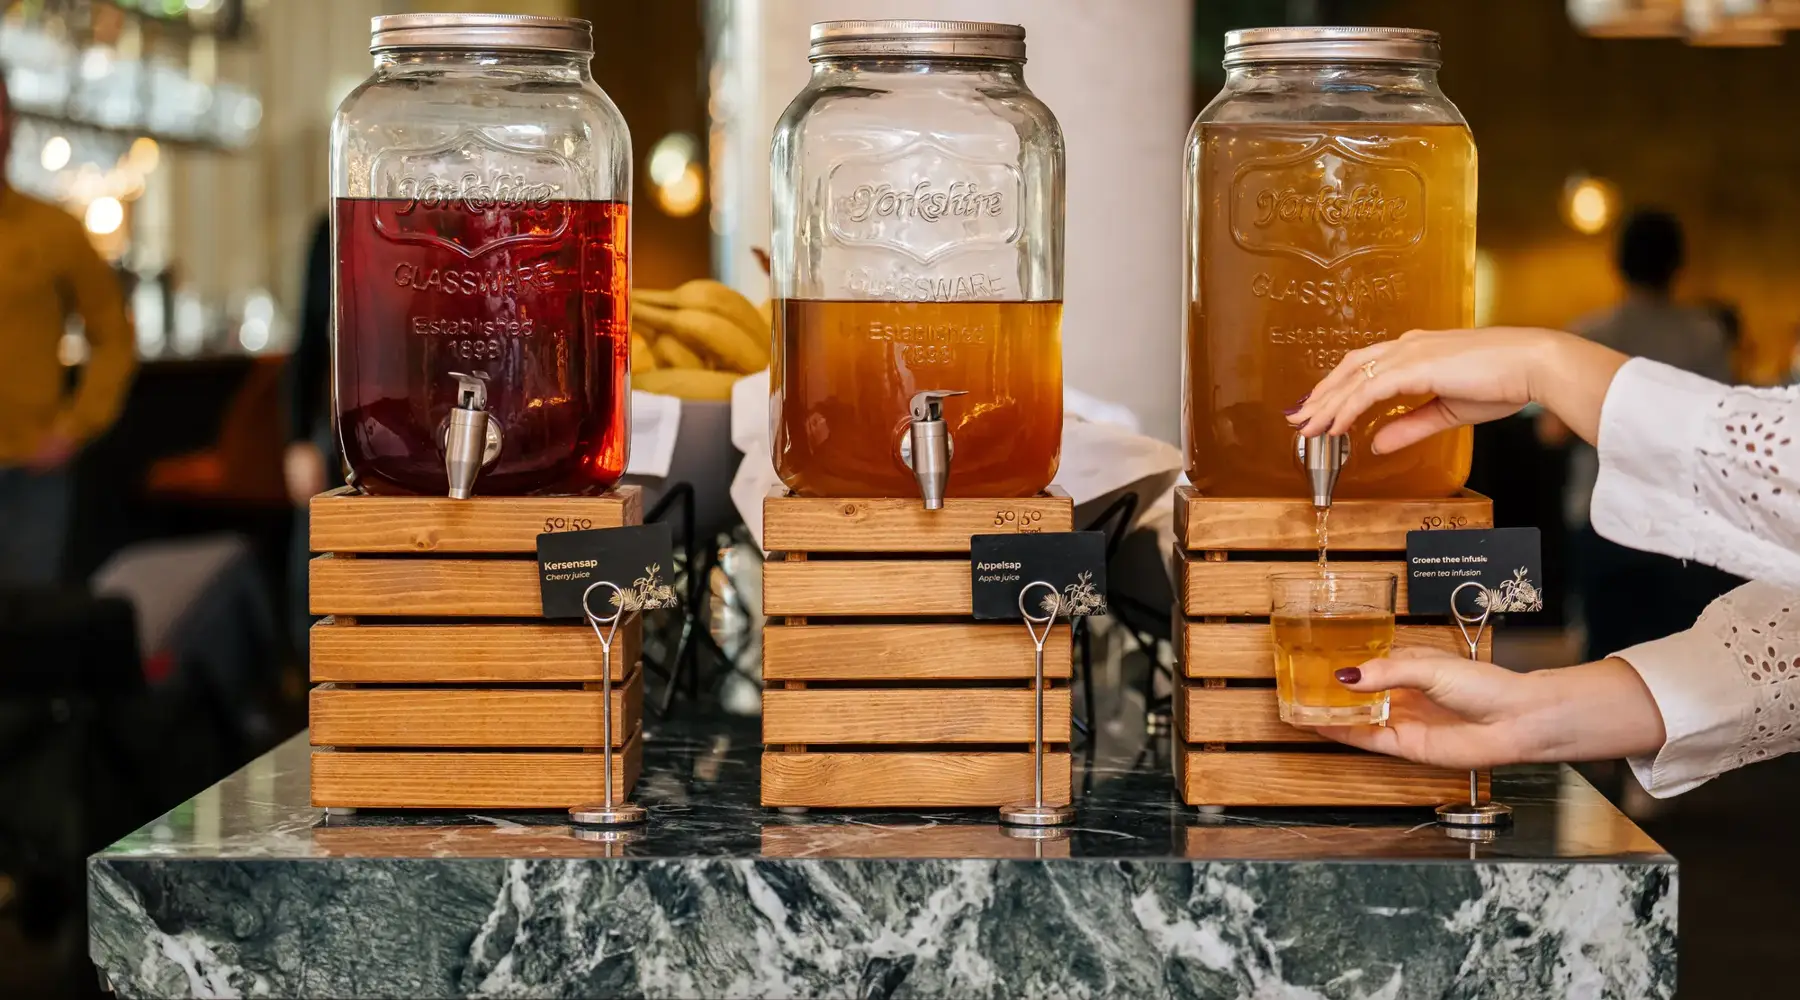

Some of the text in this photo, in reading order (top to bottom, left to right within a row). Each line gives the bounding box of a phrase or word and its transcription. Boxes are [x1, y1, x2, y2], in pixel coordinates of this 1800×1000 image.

[395, 172, 560, 216] Yorkshire
[850, 181, 1004, 223] Yorkshire
[1253, 184, 1408, 226] Yorkshire
[394, 261, 555, 296] GLASSWARE
[848, 268, 1006, 301] GLASSWARE
[1251, 272, 1408, 305] GLASSWARE
[412, 316, 534, 338] Established
[544, 558, 598, 571] Kersensap
[976, 561, 1022, 571] Appelsap
[1412, 556, 1441, 564] Groene
[545, 571, 590, 581] Cherry juice
[978, 574, 1021, 583] Apple juice
